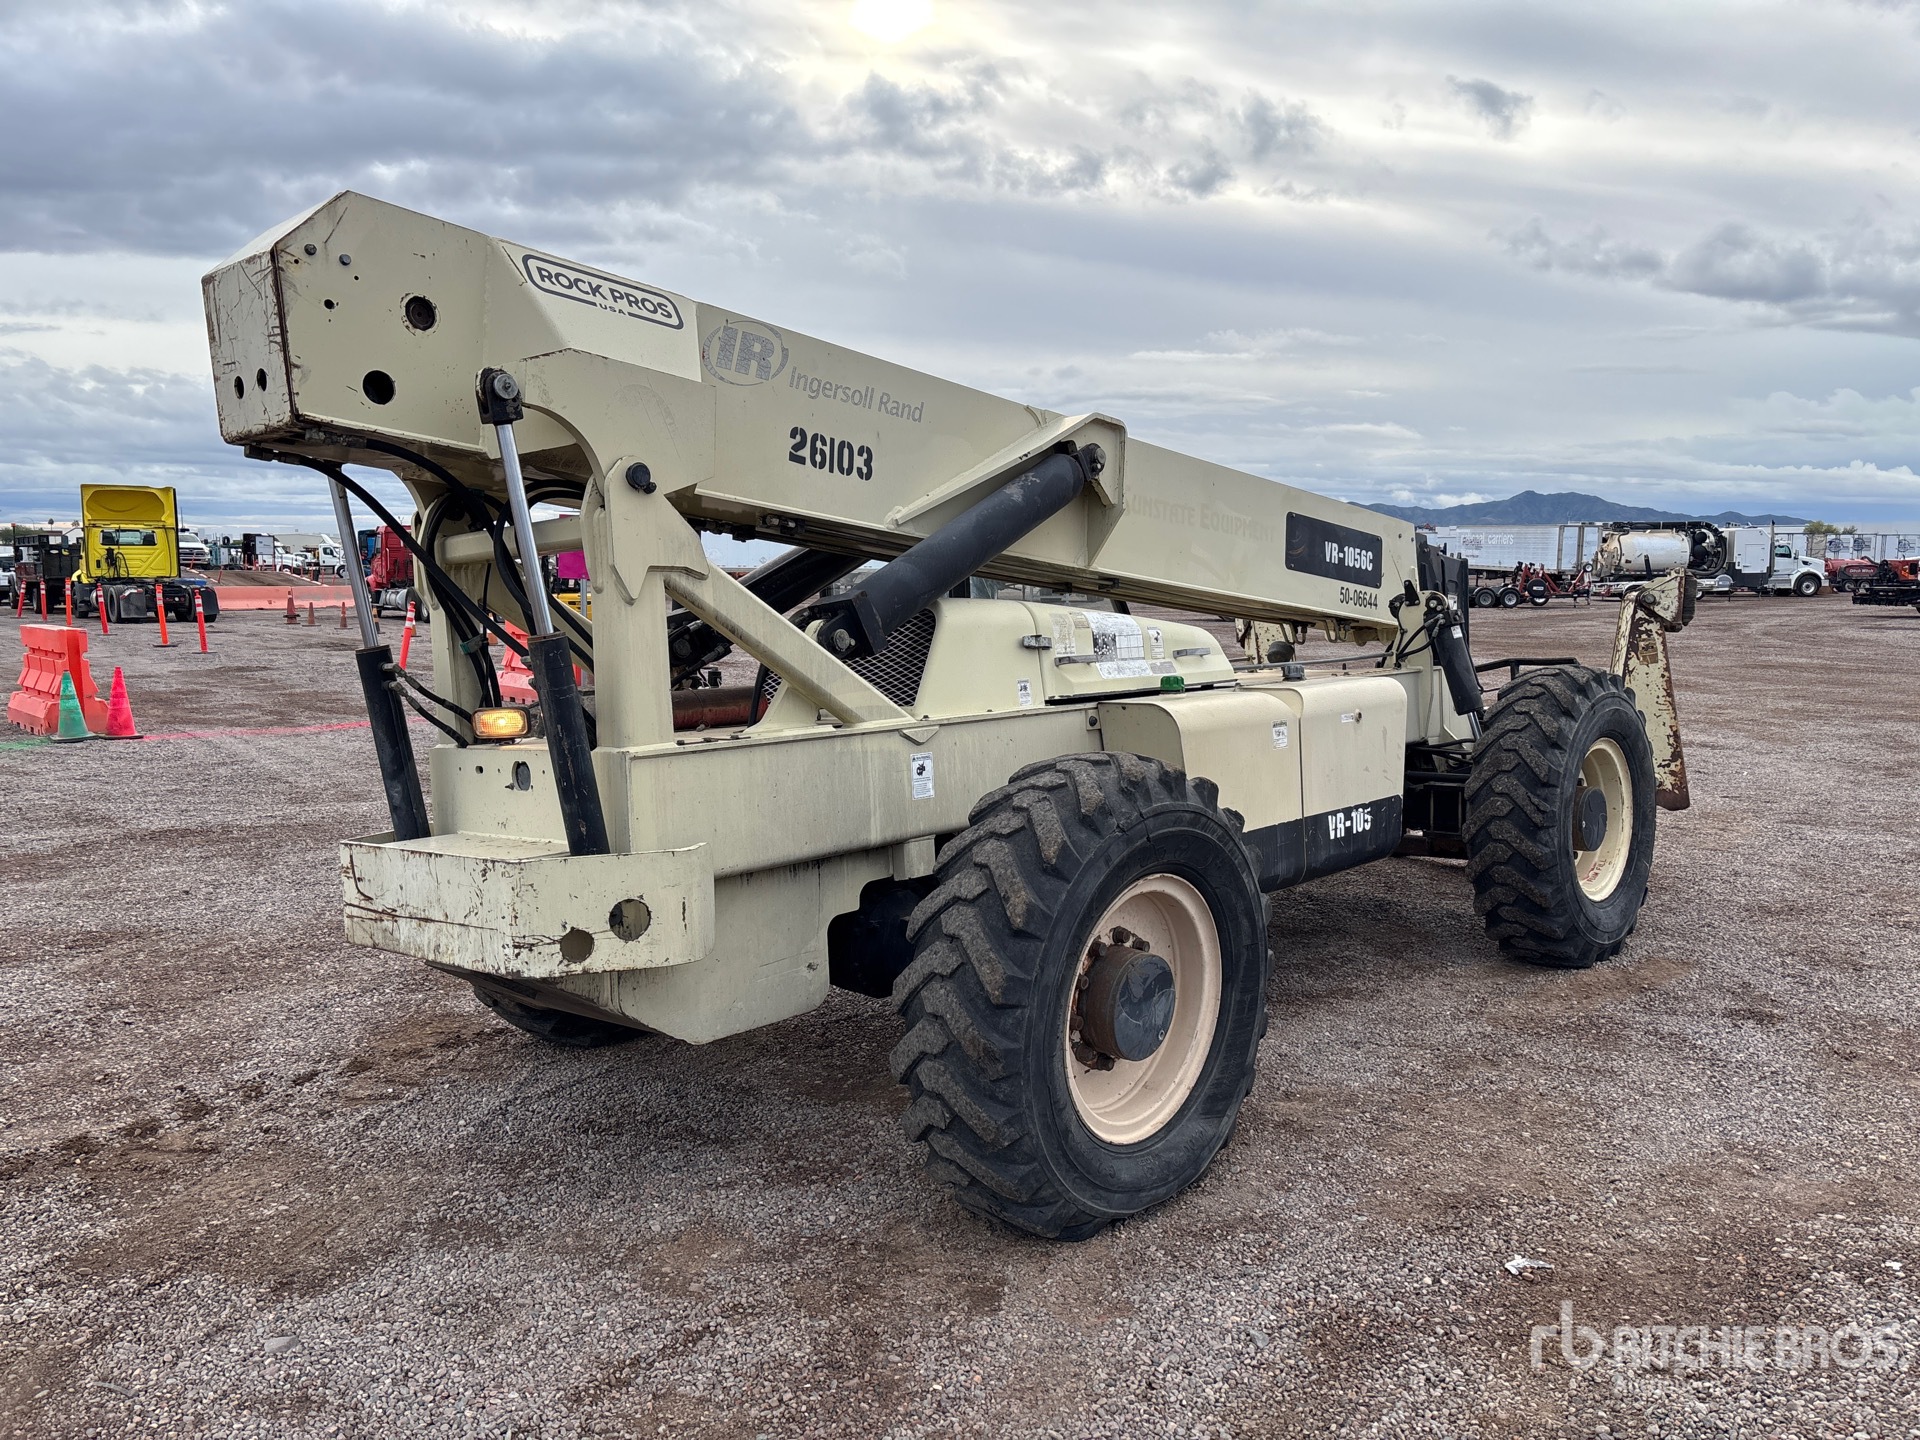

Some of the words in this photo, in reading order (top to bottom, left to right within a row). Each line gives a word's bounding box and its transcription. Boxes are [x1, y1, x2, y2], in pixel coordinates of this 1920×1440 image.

[536, 265, 609, 301] ROCK
[608, 286, 673, 319] PROS
[598, 302, 627, 316] USA
[715, 325, 775, 382] IR
[788, 366, 876, 411] Ingersoll
[877, 391, 925, 424] Rand
[788, 426, 874, 481] 26103
[1324, 540, 1374, 572] VR-1056C
[1339, 586, 1379, 611] 50-06644
[1327, 806, 1372, 840] VR-105
